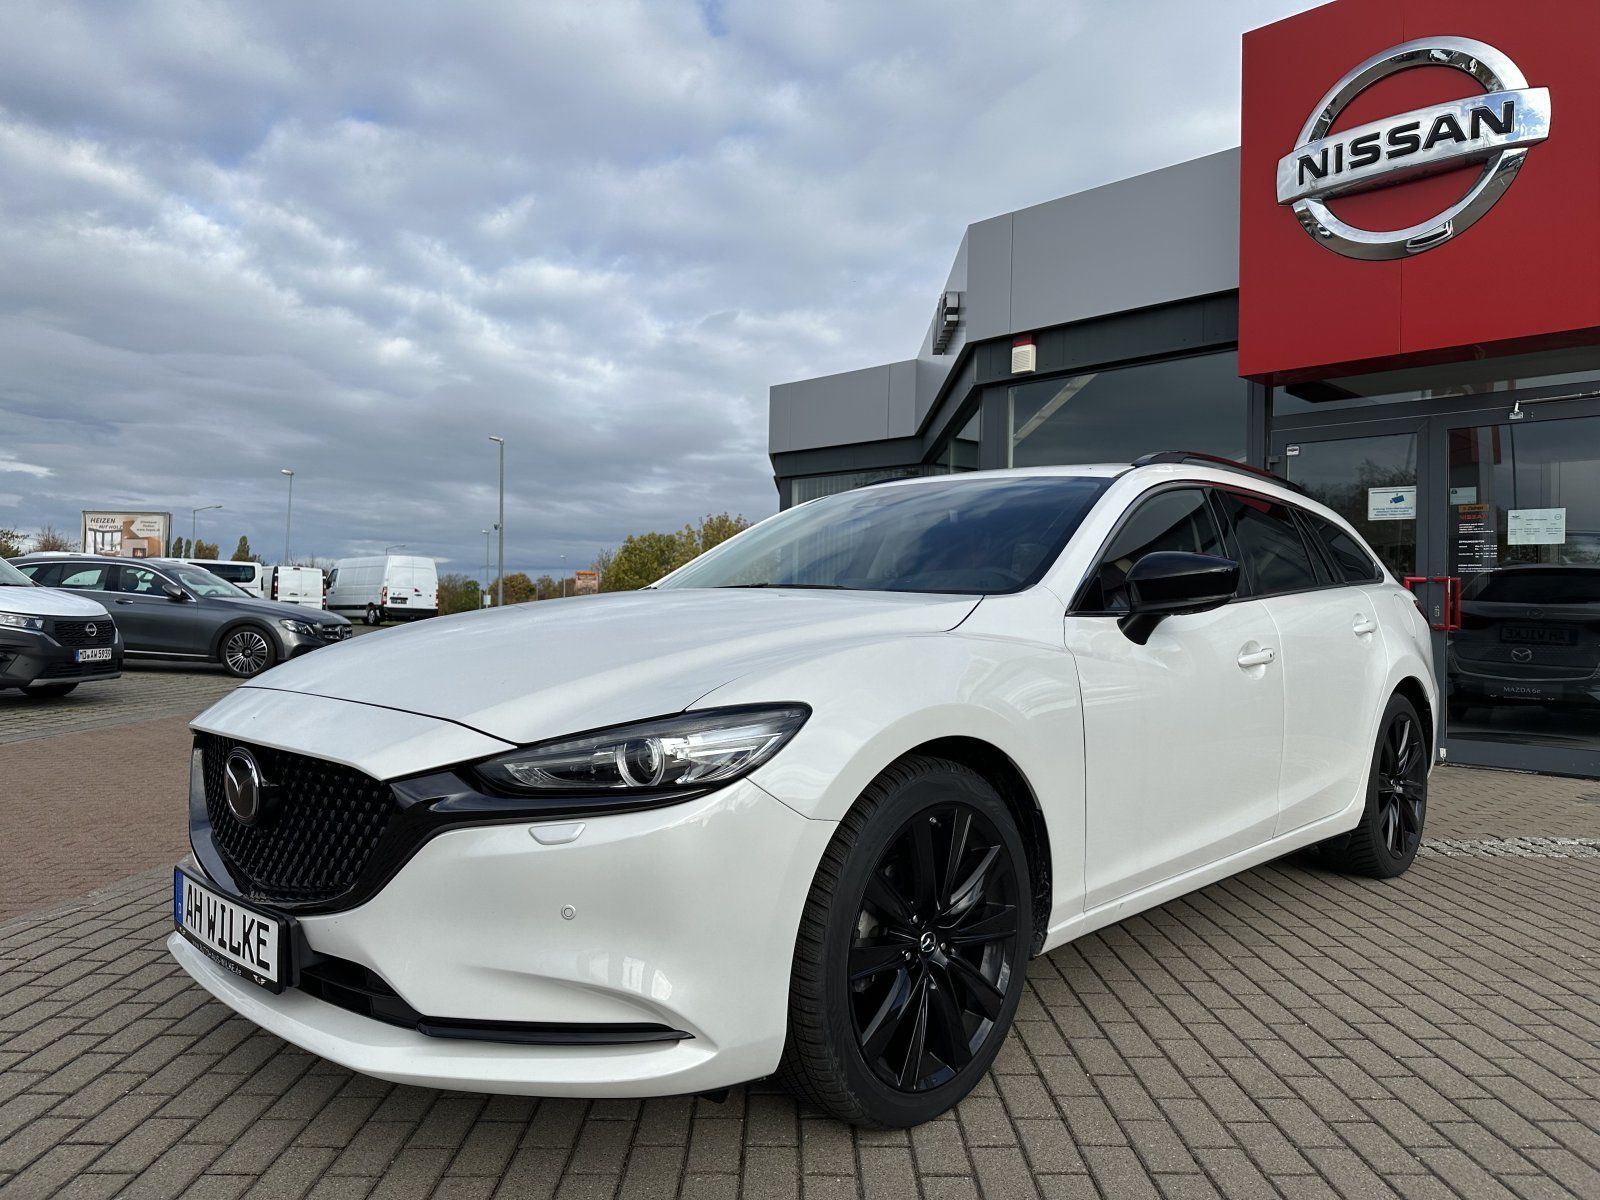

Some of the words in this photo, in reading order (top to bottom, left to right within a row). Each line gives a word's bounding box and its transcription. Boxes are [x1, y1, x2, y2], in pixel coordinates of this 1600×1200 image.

[1296, 100, 1516, 186] NISSAN
[185, 884, 203, 934] AH
[207, 896, 270, 971] WILKE
